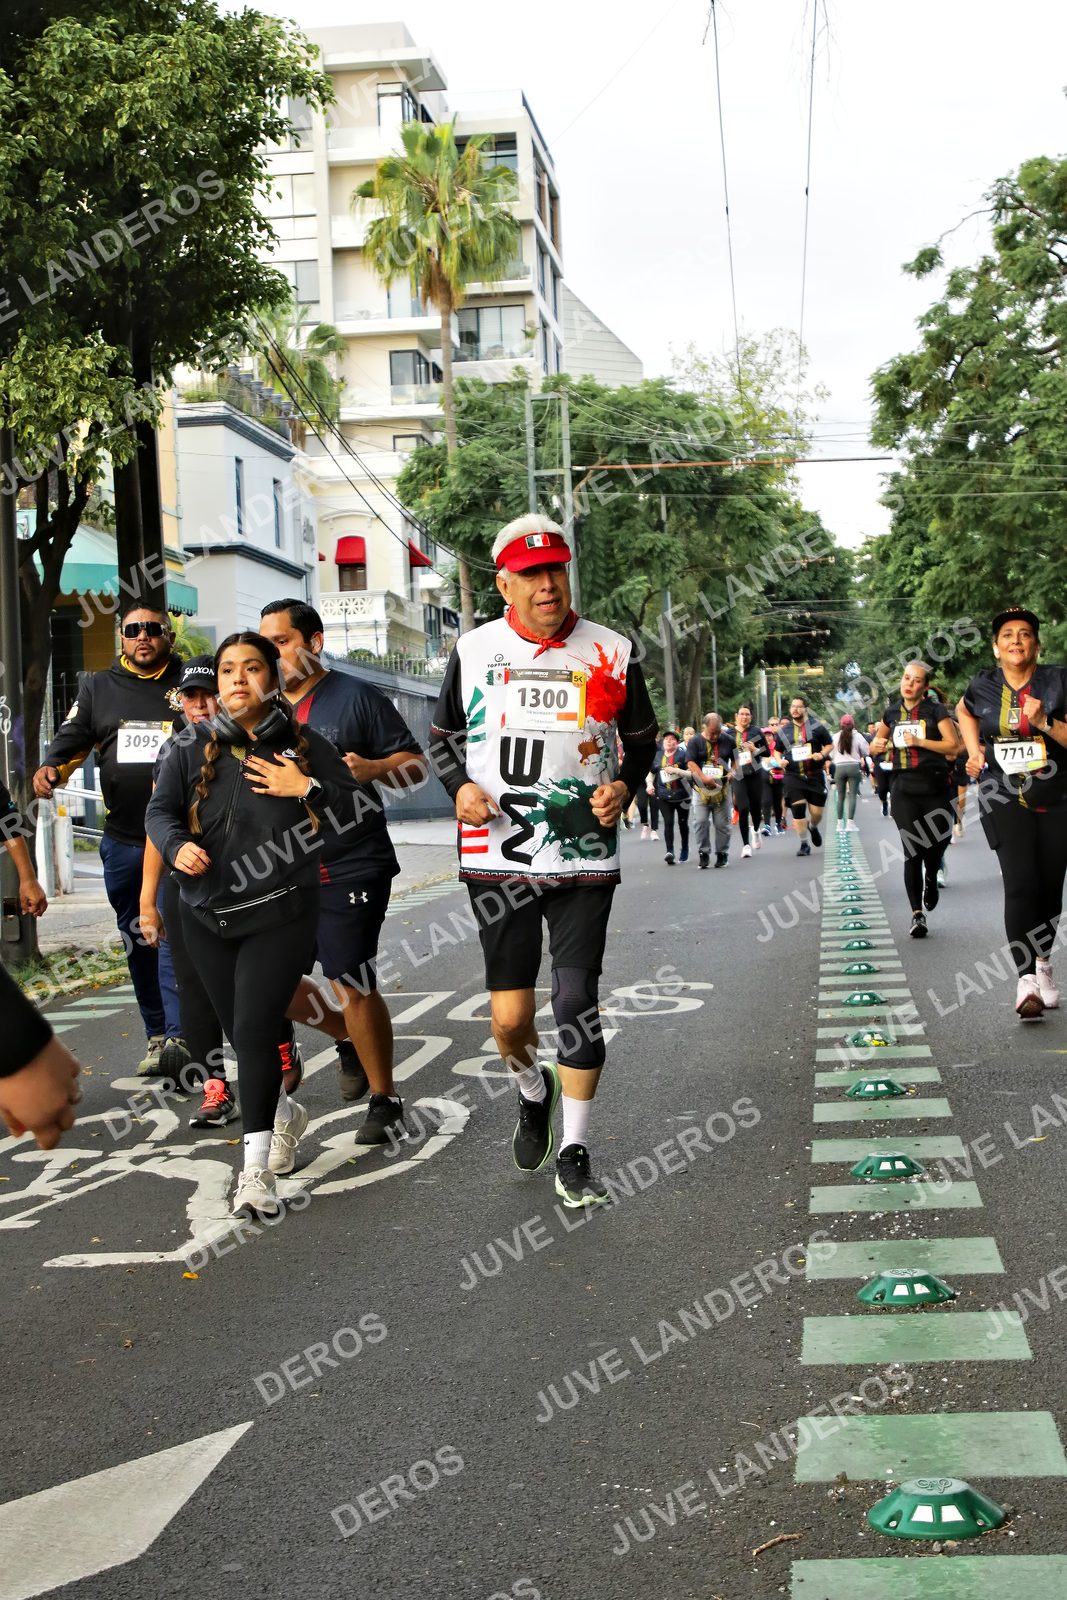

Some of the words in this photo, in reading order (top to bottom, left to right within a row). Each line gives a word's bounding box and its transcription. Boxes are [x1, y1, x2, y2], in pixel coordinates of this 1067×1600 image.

[517, 687, 569, 709] 1300
[124, 735, 159, 748] 3095
[1000, 745, 1034, 761] 7714
